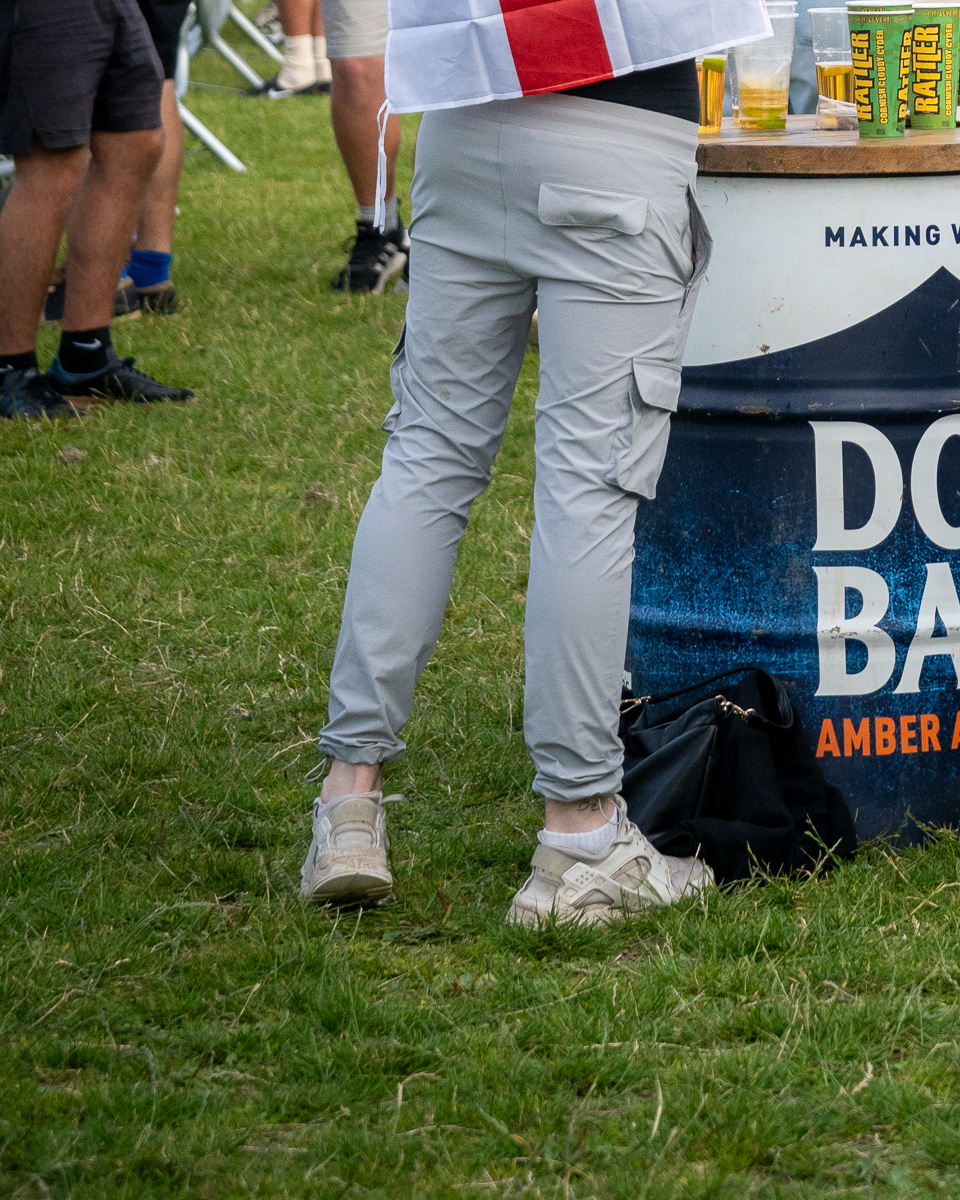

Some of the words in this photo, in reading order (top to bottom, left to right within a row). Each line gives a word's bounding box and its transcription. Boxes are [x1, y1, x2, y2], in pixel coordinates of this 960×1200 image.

[876, 29, 885, 55] CYDER
[945, 23, 953, 48] CYDER
[851, 30, 874, 122] RATTLER
[876, 56, 887, 87] CLOUDY
[912, 24, 942, 115] RATTLER
[878, 87, 888, 124] CORNISH
[825, 225, 940, 247] MAKING
[815, 713, 942, 758] AMBER
